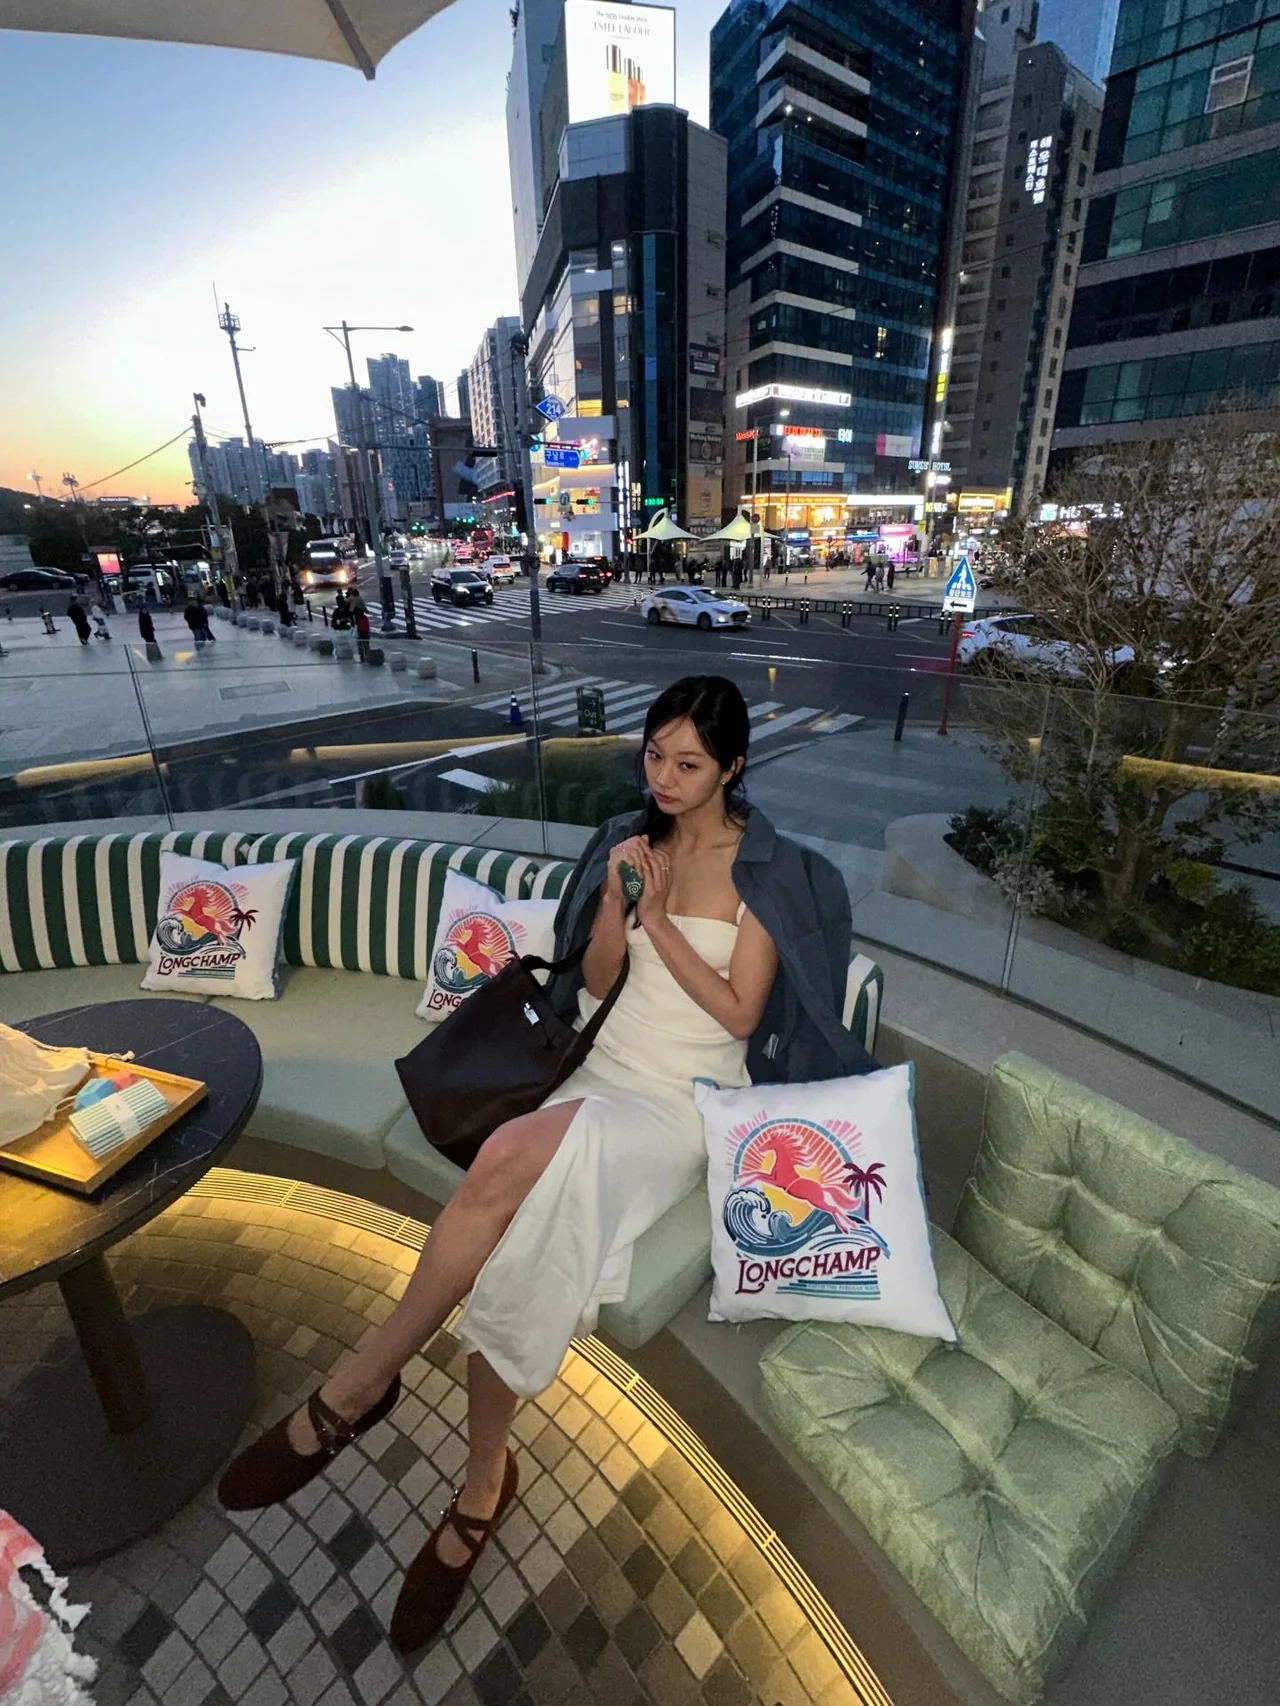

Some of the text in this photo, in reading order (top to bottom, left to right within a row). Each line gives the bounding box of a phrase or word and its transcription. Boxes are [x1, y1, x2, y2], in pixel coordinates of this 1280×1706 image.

[545, 403, 562, 416] 214
[546, 450, 565, 461] 구남로
[157, 952, 241, 976] LONGCHAMP
[734, 1246, 882, 1295] LONGCHAMP
